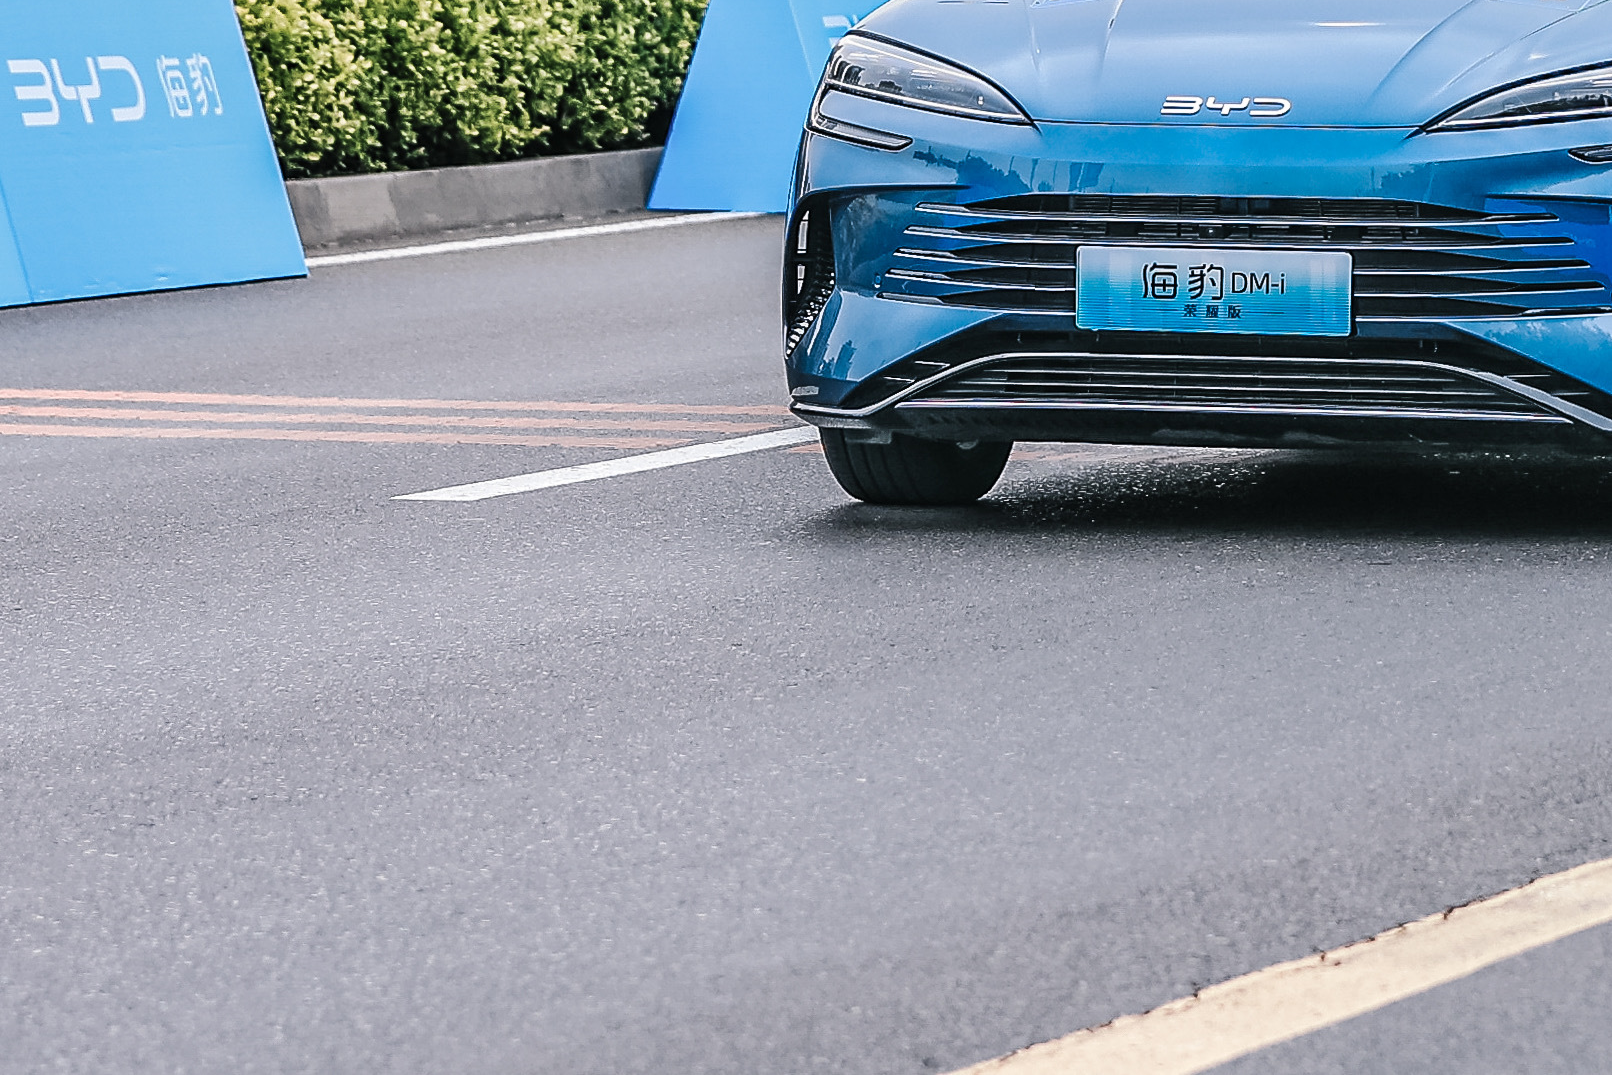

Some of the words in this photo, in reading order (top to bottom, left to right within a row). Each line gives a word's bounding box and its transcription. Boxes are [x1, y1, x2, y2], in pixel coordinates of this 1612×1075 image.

[7, 55, 146, 126] BYD
[156, 53, 223, 117] 海豹
[1160, 95, 1292, 116] BYD
[1141, 262, 1225, 301] 海豹
[1231, 271, 1287, 295] DM-i
[1183, 304, 1242, 320] 荣耀版
